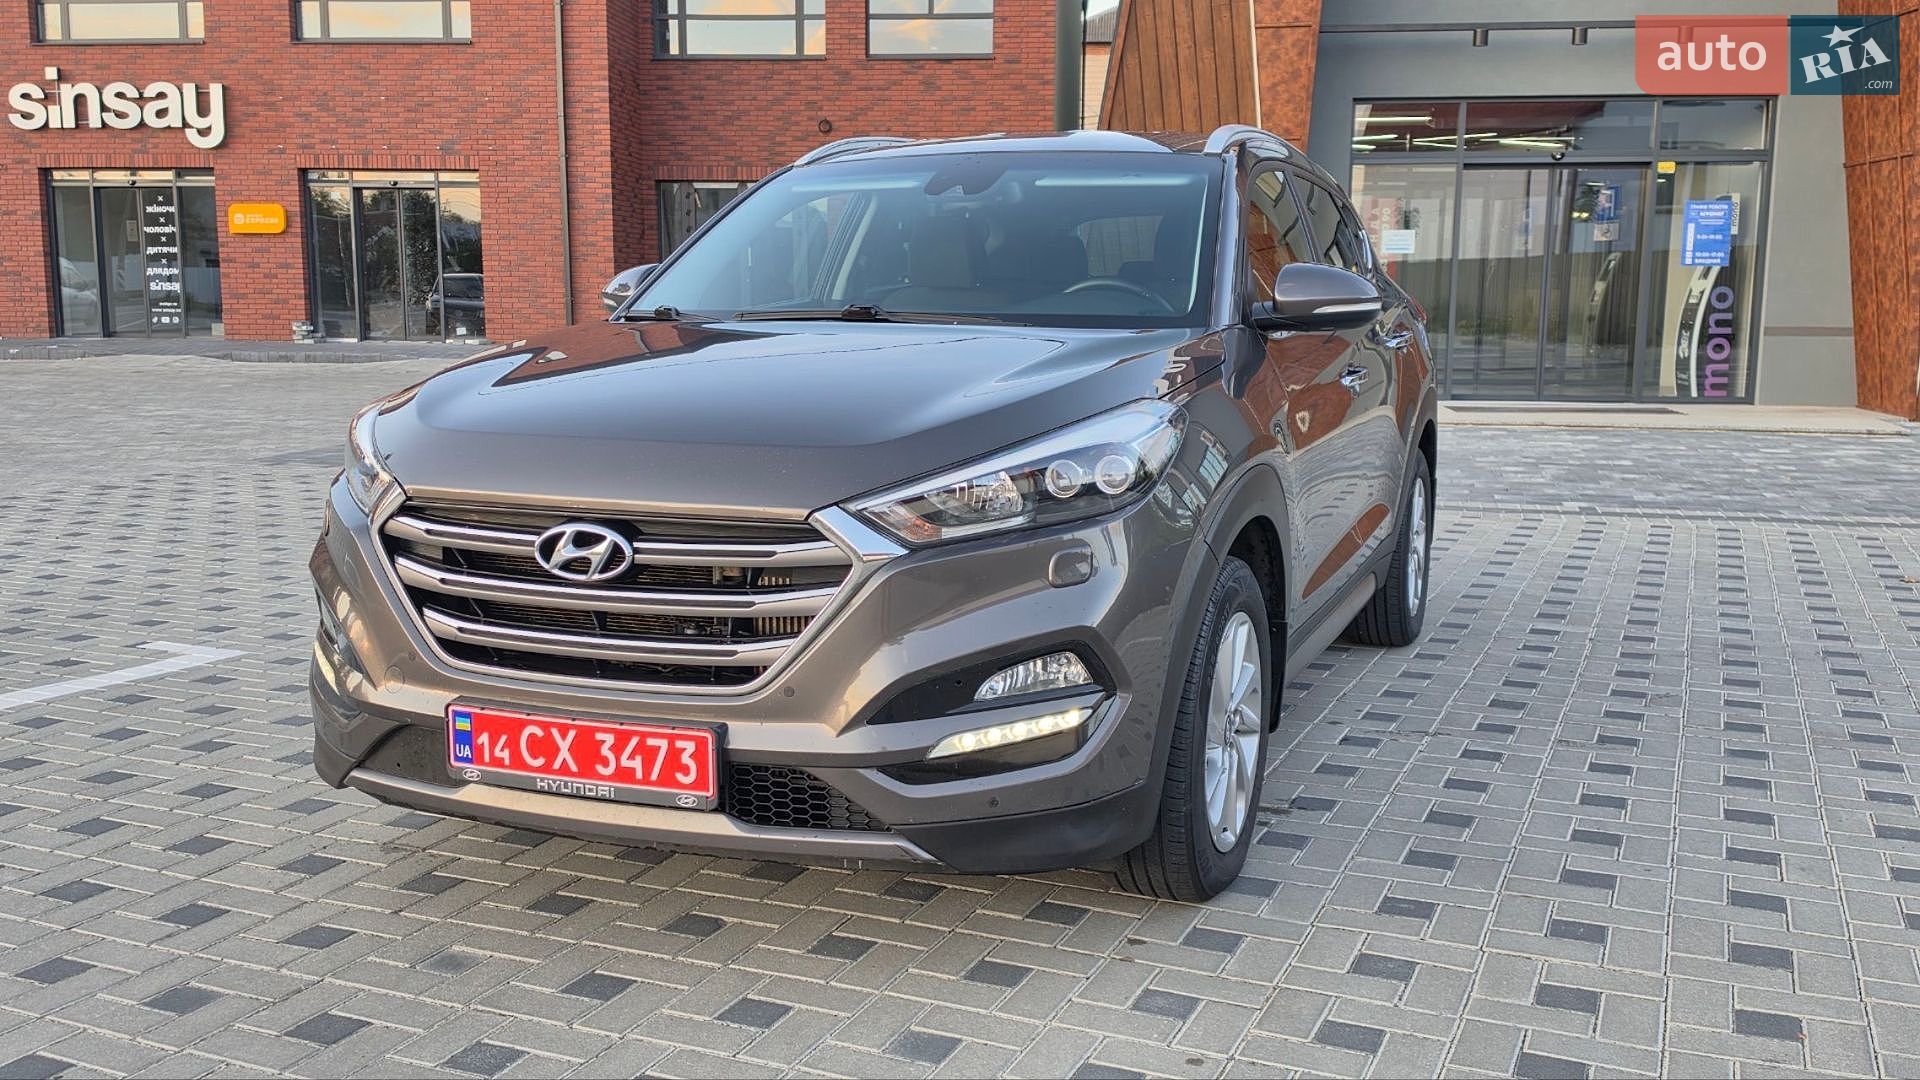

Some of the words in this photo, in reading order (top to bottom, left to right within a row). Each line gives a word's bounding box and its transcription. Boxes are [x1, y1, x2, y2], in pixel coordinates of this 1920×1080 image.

[8, 66, 225, 149] sinsay
[1704, 285, 1734, 396] mono
[456, 743, 472, 759] UA
[476, 732, 511, 766] 14
[519, 725, 579, 773] CX
[594, 732, 698, 785] 3473
[536, 778, 616, 798] HYUNDAI
